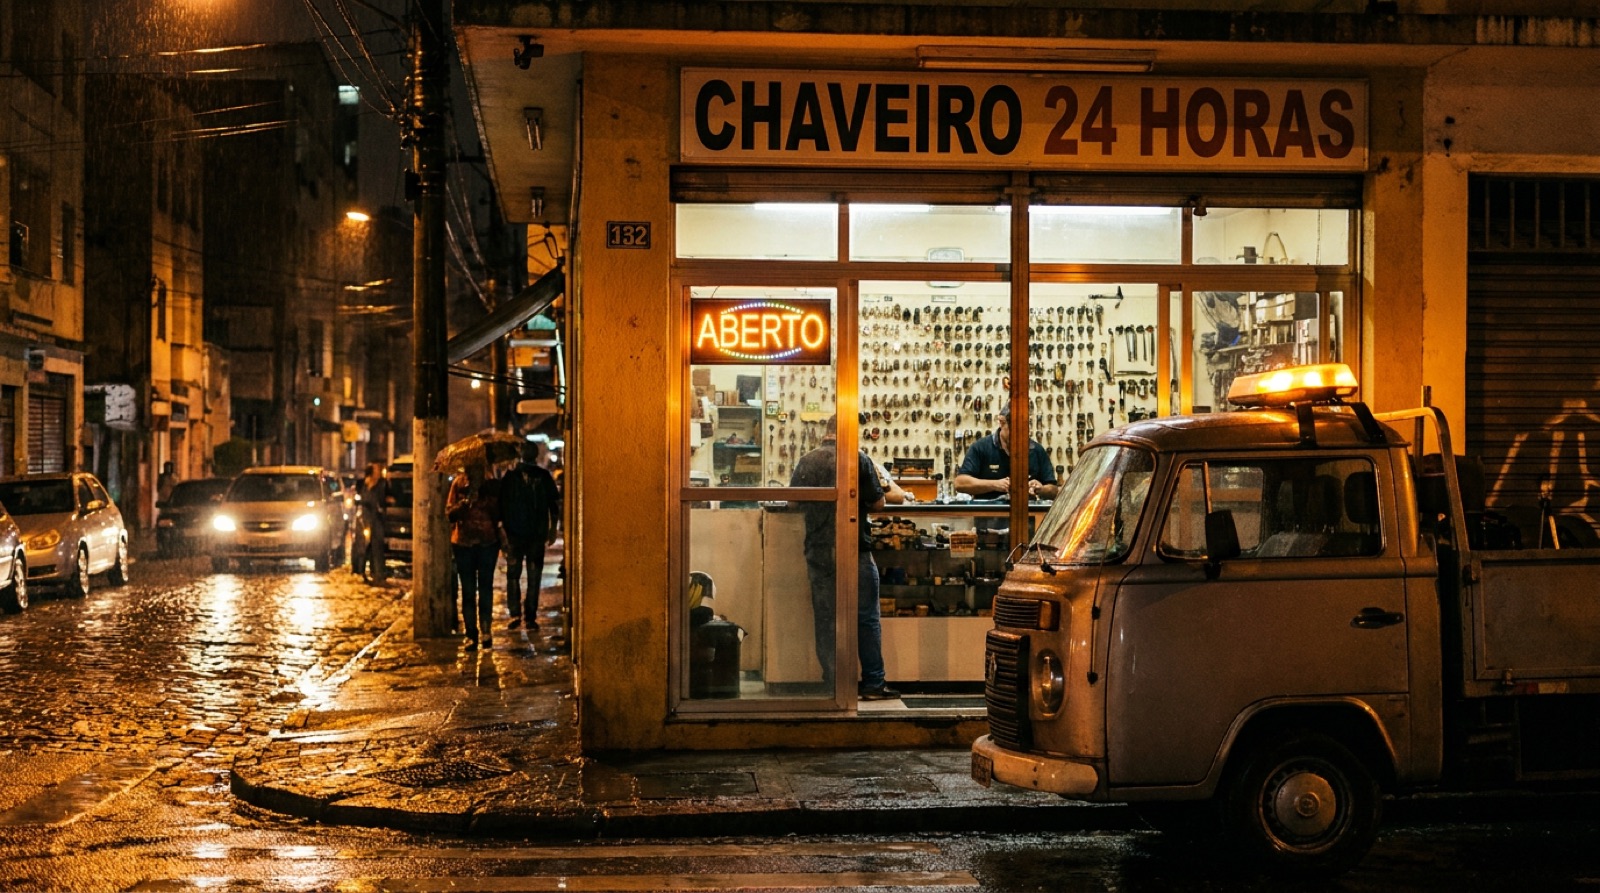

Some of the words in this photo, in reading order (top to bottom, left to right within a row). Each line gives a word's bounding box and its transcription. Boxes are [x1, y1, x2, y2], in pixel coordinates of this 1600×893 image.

[695, 79, 1022, 155] CHAVEIRO
[1043, 85, 1117, 156] 24
[1140, 87, 1355, 159] HORAS
[612, 226, 647, 245] 132
[697, 312, 826, 350] ABERTO
